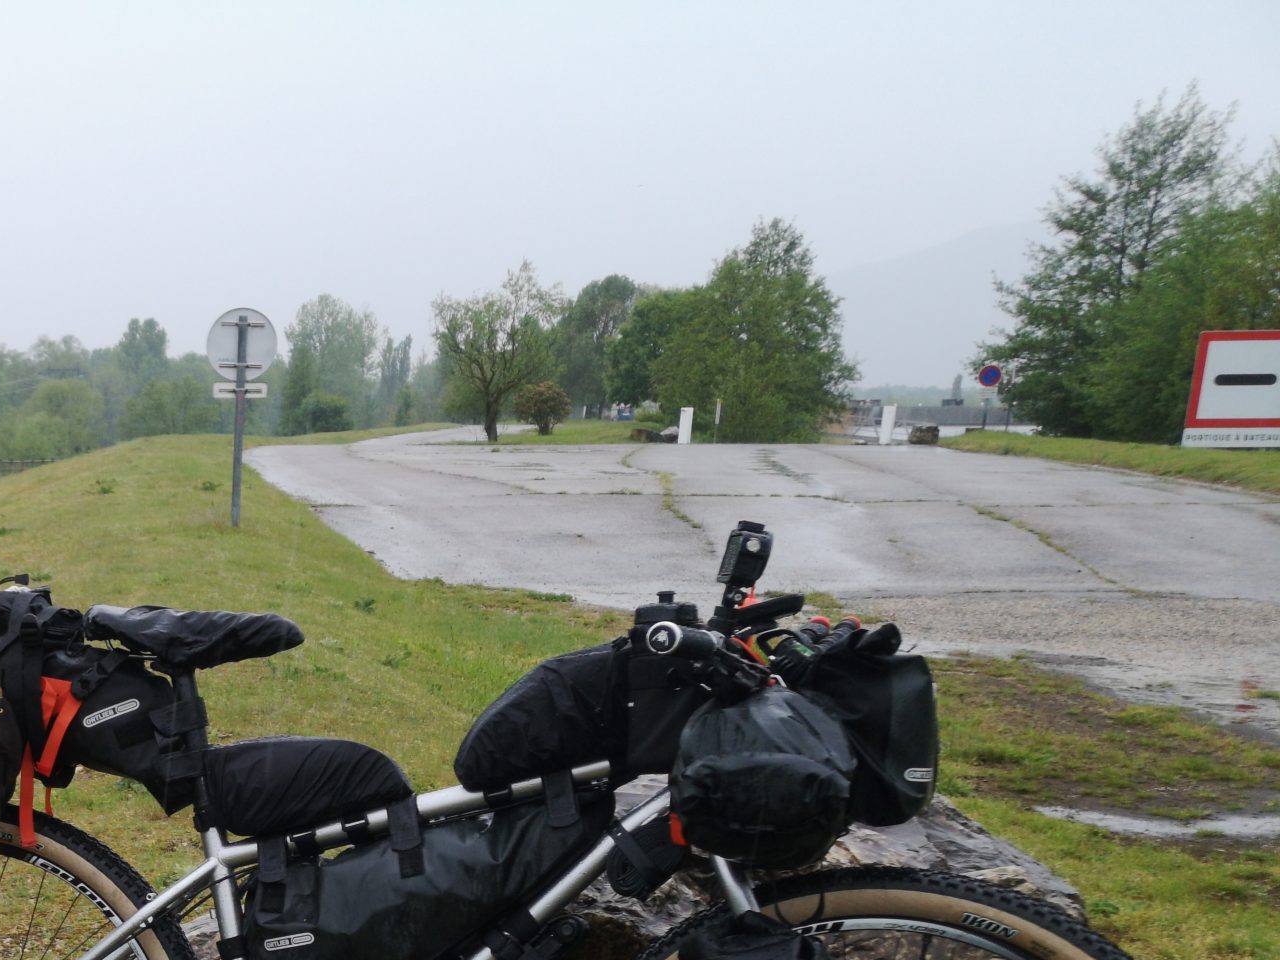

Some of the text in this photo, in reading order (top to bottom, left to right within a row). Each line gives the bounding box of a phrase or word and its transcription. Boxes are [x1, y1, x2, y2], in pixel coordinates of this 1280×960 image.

[86, 708, 115, 725] ORTLIEB
[961, 912, 1018, 939] IKON
[266, 938, 290, 948] ORTLIEB
